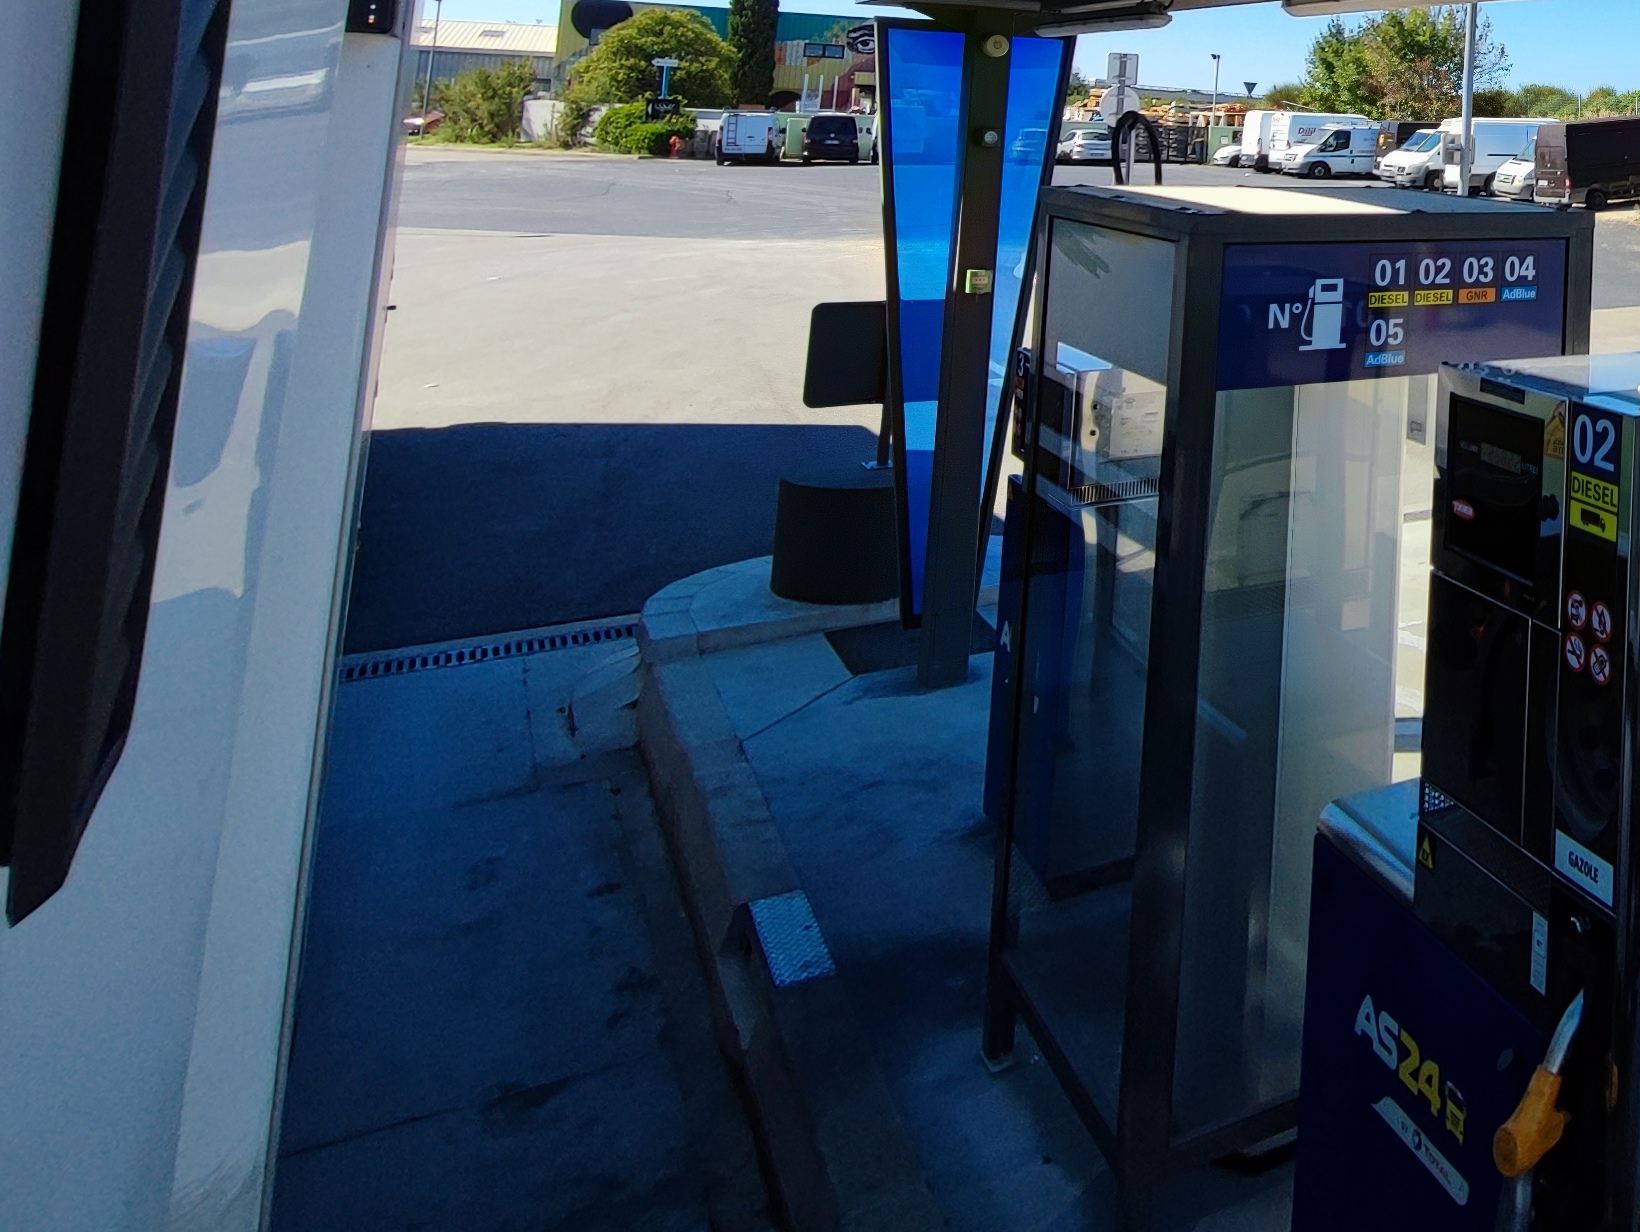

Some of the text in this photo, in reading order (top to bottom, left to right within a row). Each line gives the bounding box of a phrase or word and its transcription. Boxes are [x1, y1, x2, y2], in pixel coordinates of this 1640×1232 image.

[1374, 255, 1536, 286] 01 02 03 04
[1369, 288, 1536, 305] DIESEL DIESEL GNR AdBlue
[1370, 319, 1404, 346] 05
[1365, 354, 1404, 365] AdBlue
[1573, 414, 1615, 472] 02
[1572, 479, 1617, 509] DIESEL
[1568, 850, 1599, 884] GAZOLE
[1354, 993, 1442, 1118] AS24
